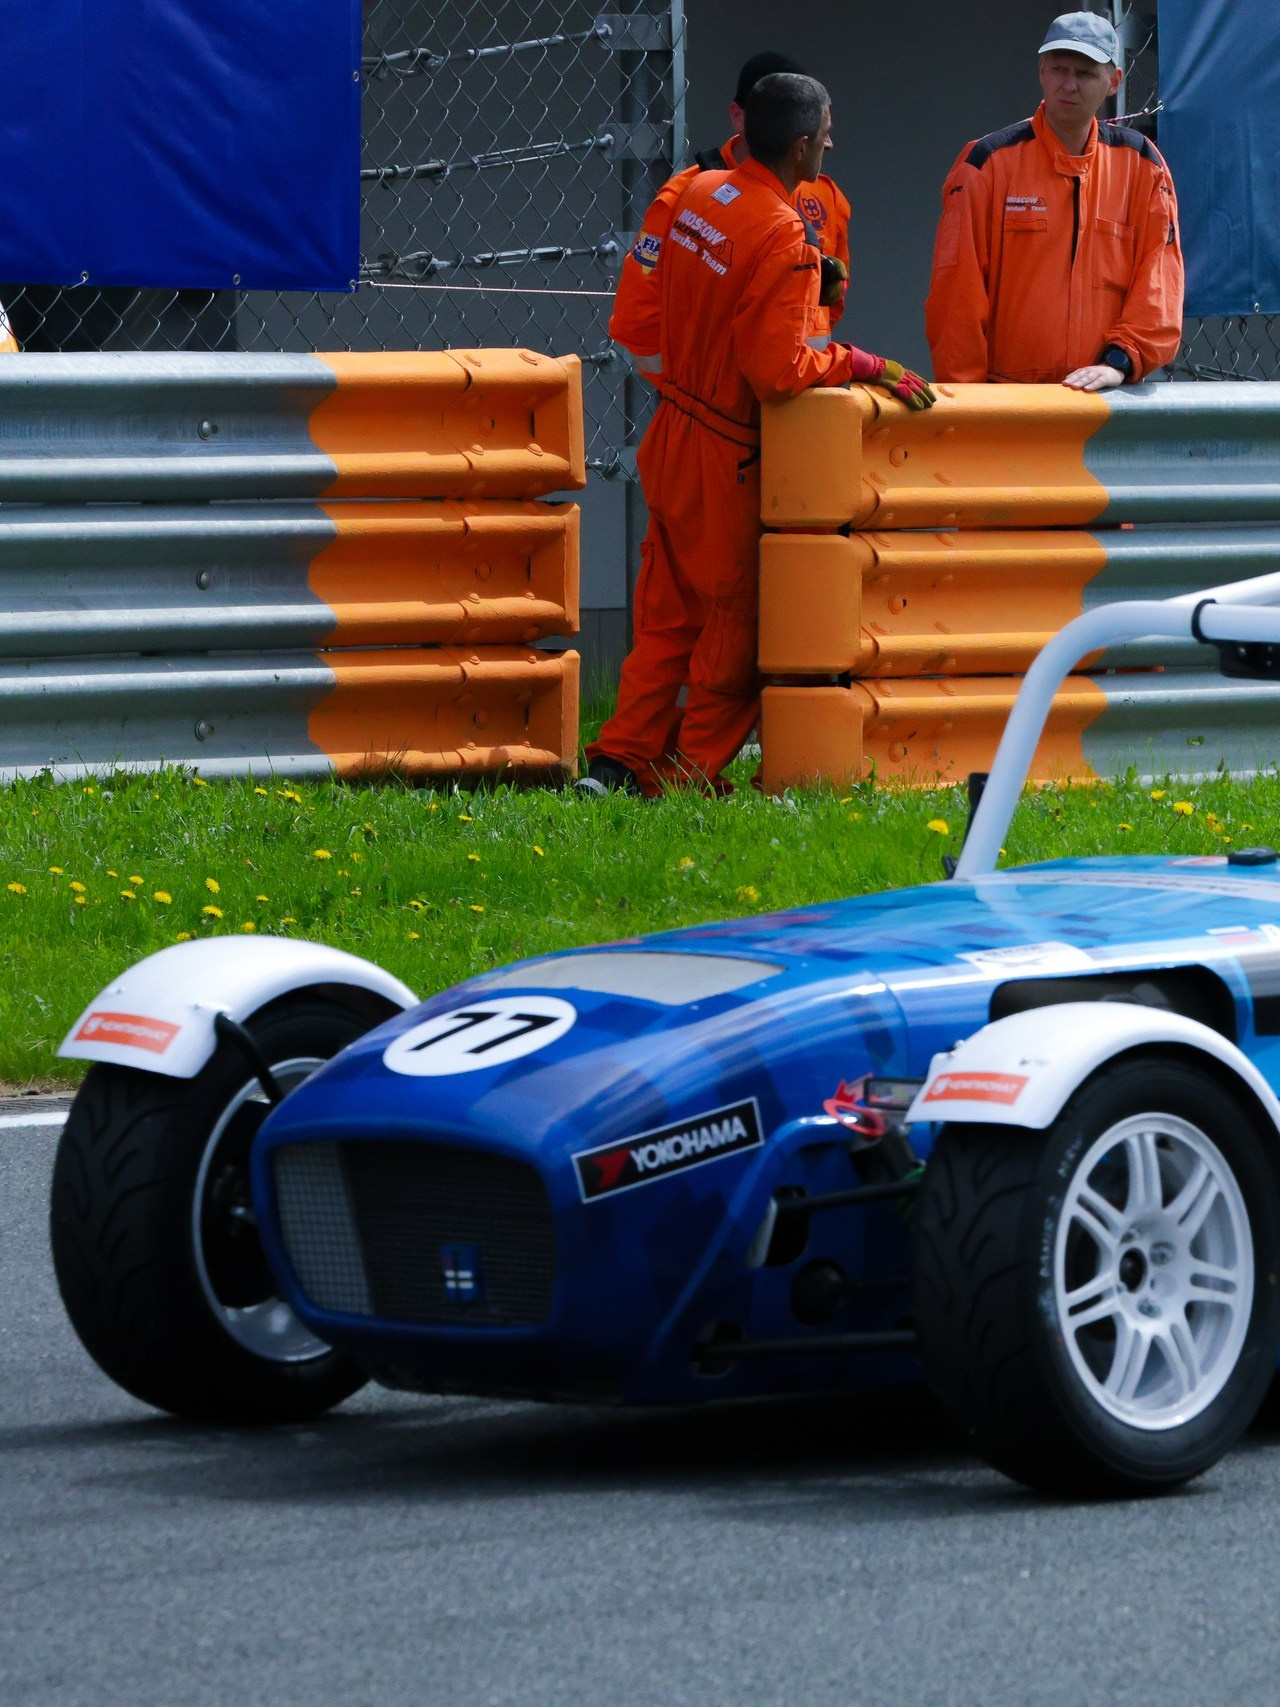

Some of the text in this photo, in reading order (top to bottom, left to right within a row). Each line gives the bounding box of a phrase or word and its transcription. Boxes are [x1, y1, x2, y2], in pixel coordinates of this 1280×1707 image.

[701, 249, 727, 275] Team
[404, 1011, 562, 1054] 77
[628, 1115, 748, 1173] YOKOHAMA
